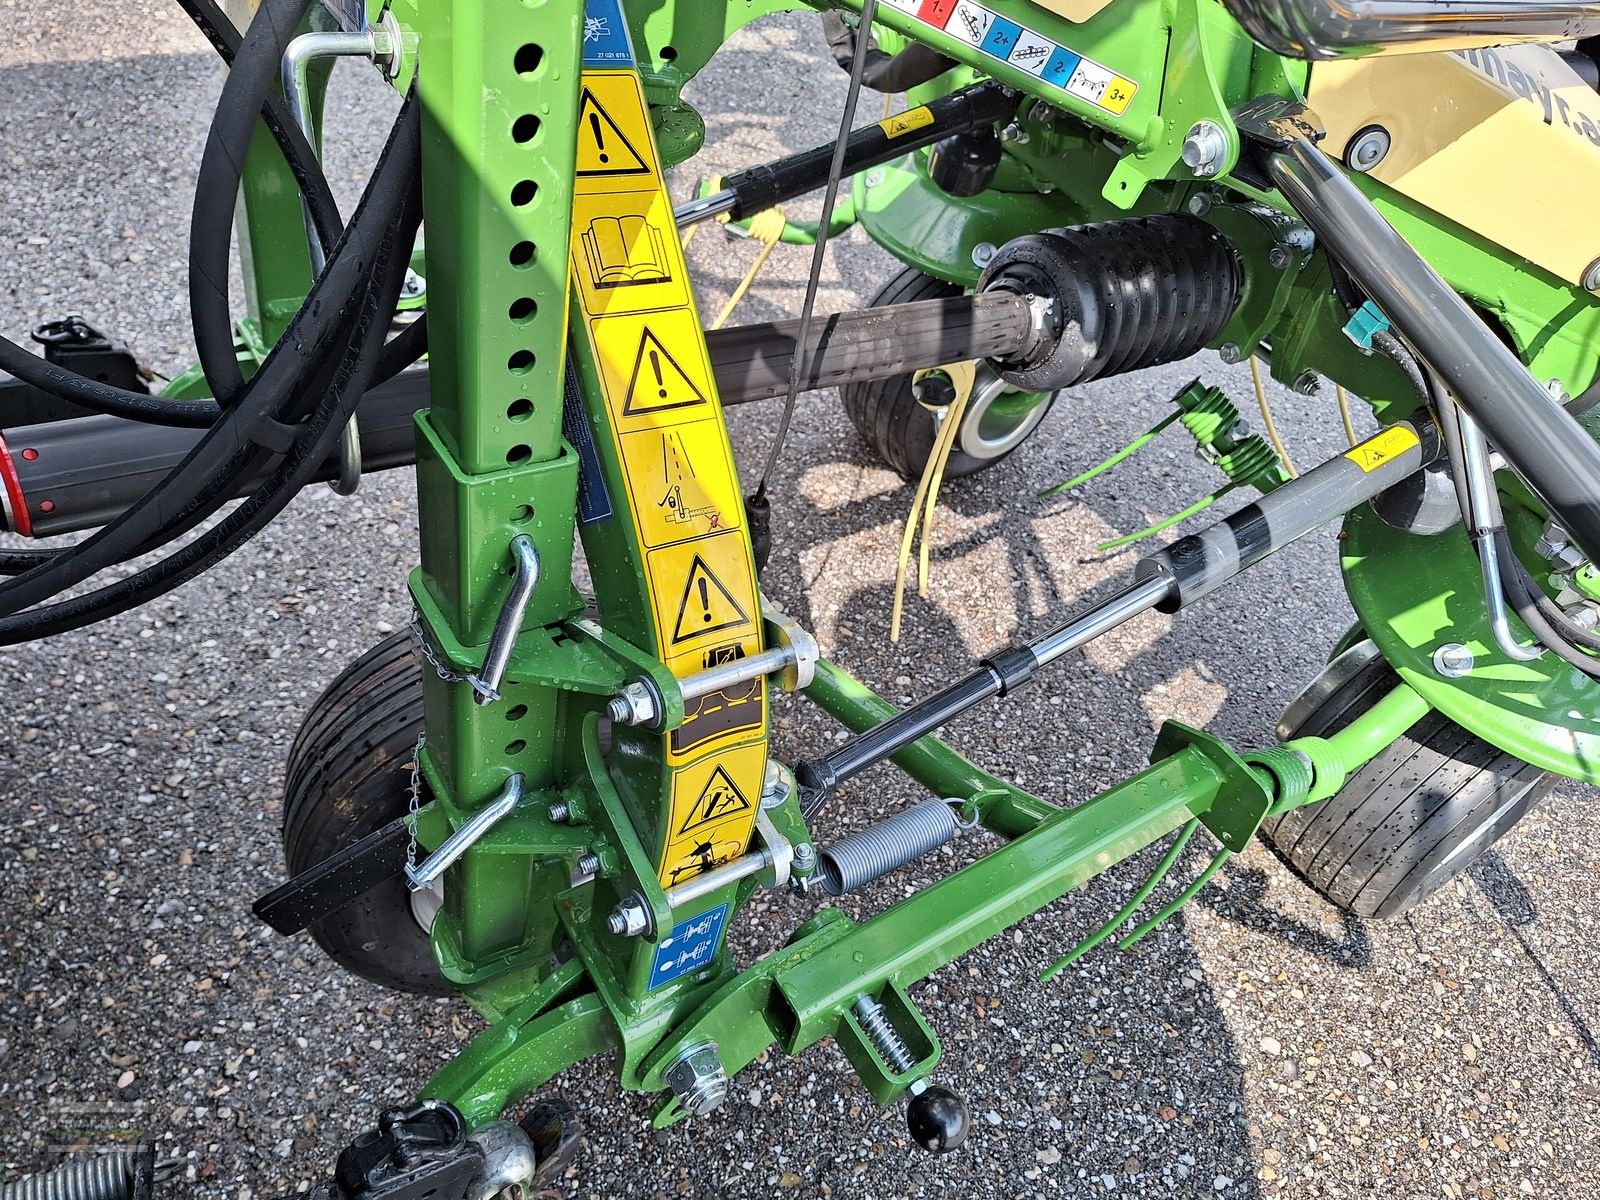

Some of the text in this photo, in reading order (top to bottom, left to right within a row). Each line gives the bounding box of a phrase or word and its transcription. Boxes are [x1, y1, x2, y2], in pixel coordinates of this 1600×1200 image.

[992, 31, 1010, 46] 2+
[1053, 61, 1067, 74] 2-
[1109, 88, 1126, 102] 3+
